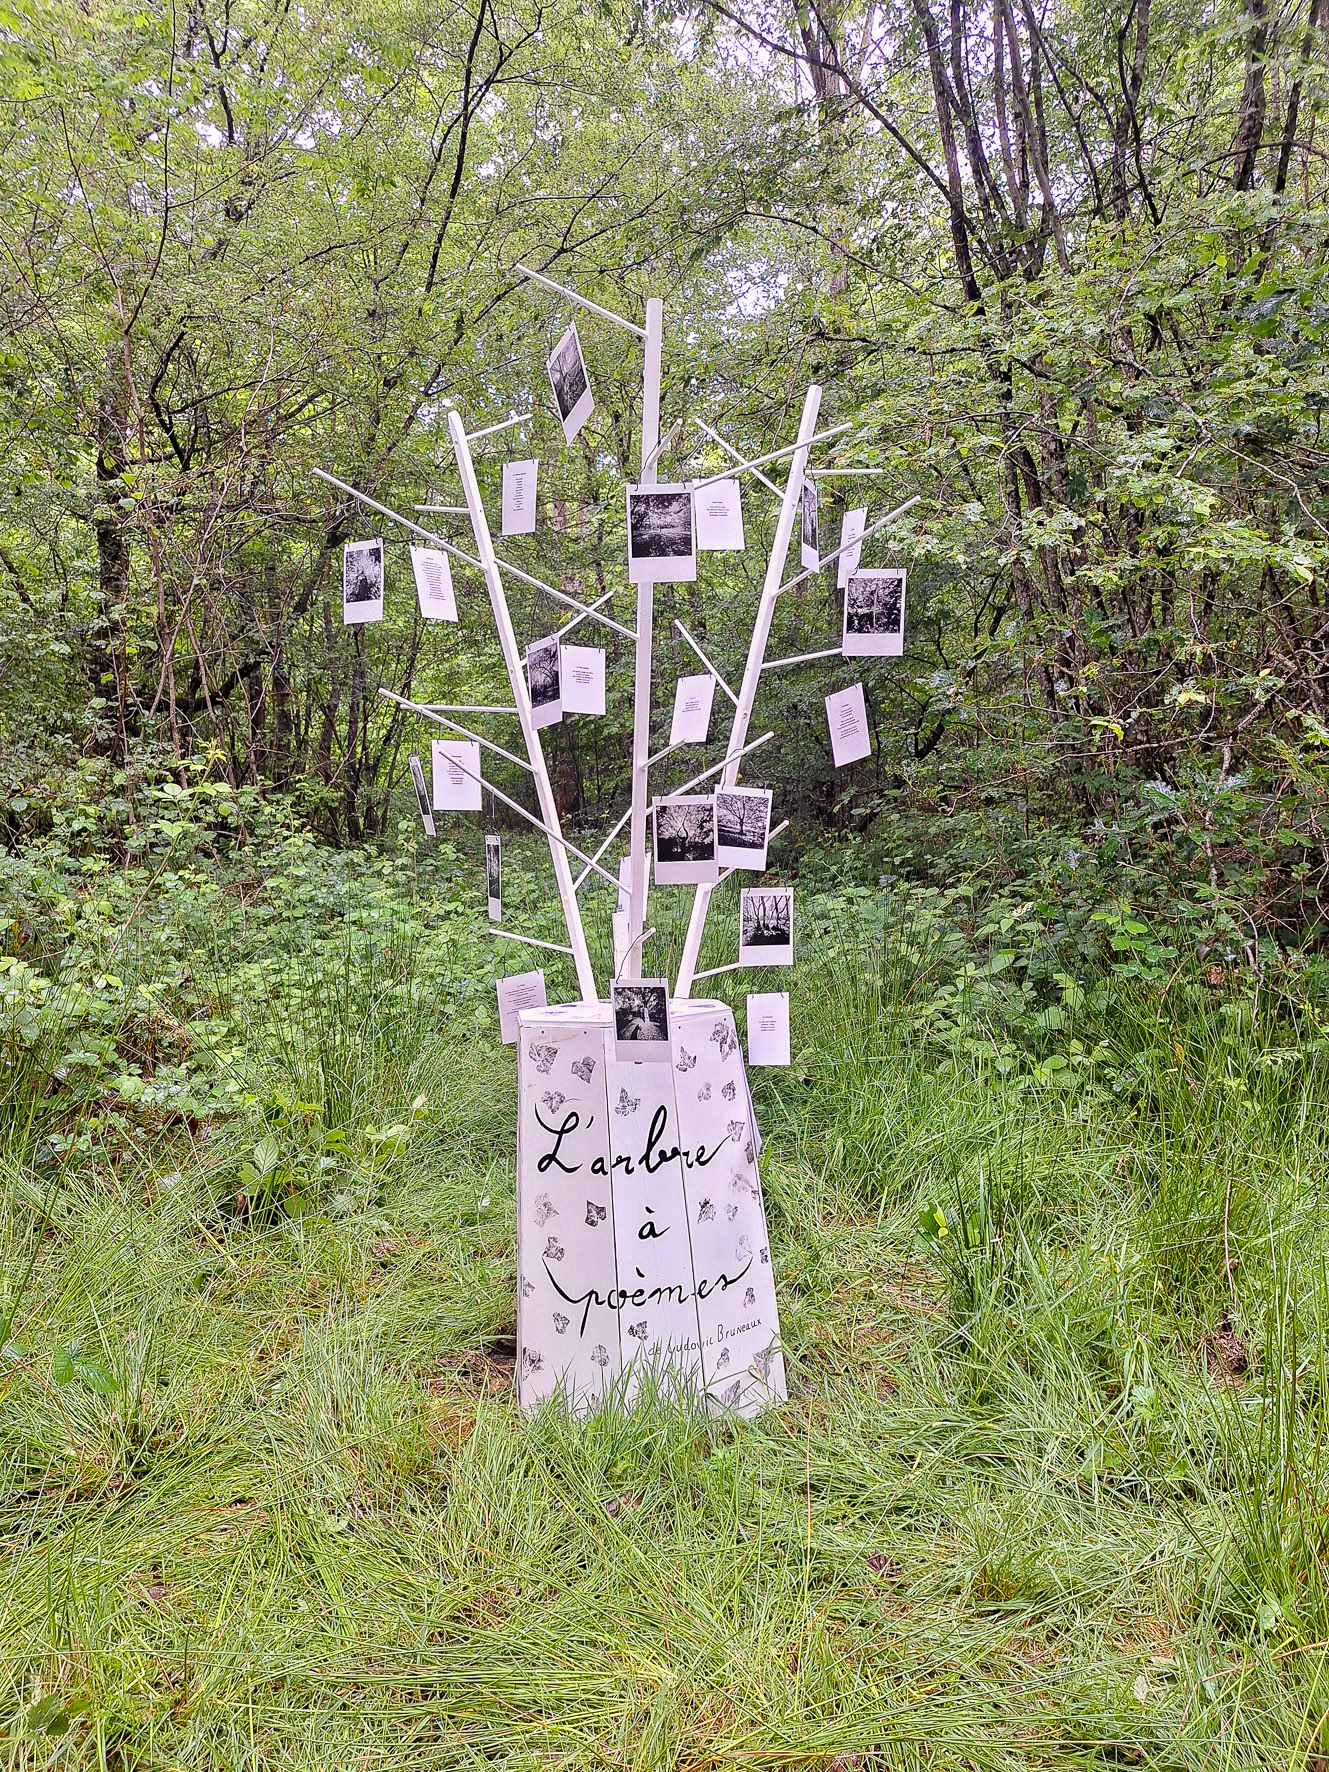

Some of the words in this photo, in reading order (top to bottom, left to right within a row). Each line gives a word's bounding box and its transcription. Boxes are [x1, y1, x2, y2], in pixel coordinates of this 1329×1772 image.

[535, 1103, 732, 1175] L'arbre
[638, 1206, 670, 1240] à
[541, 1255, 753, 1338] poèmes
